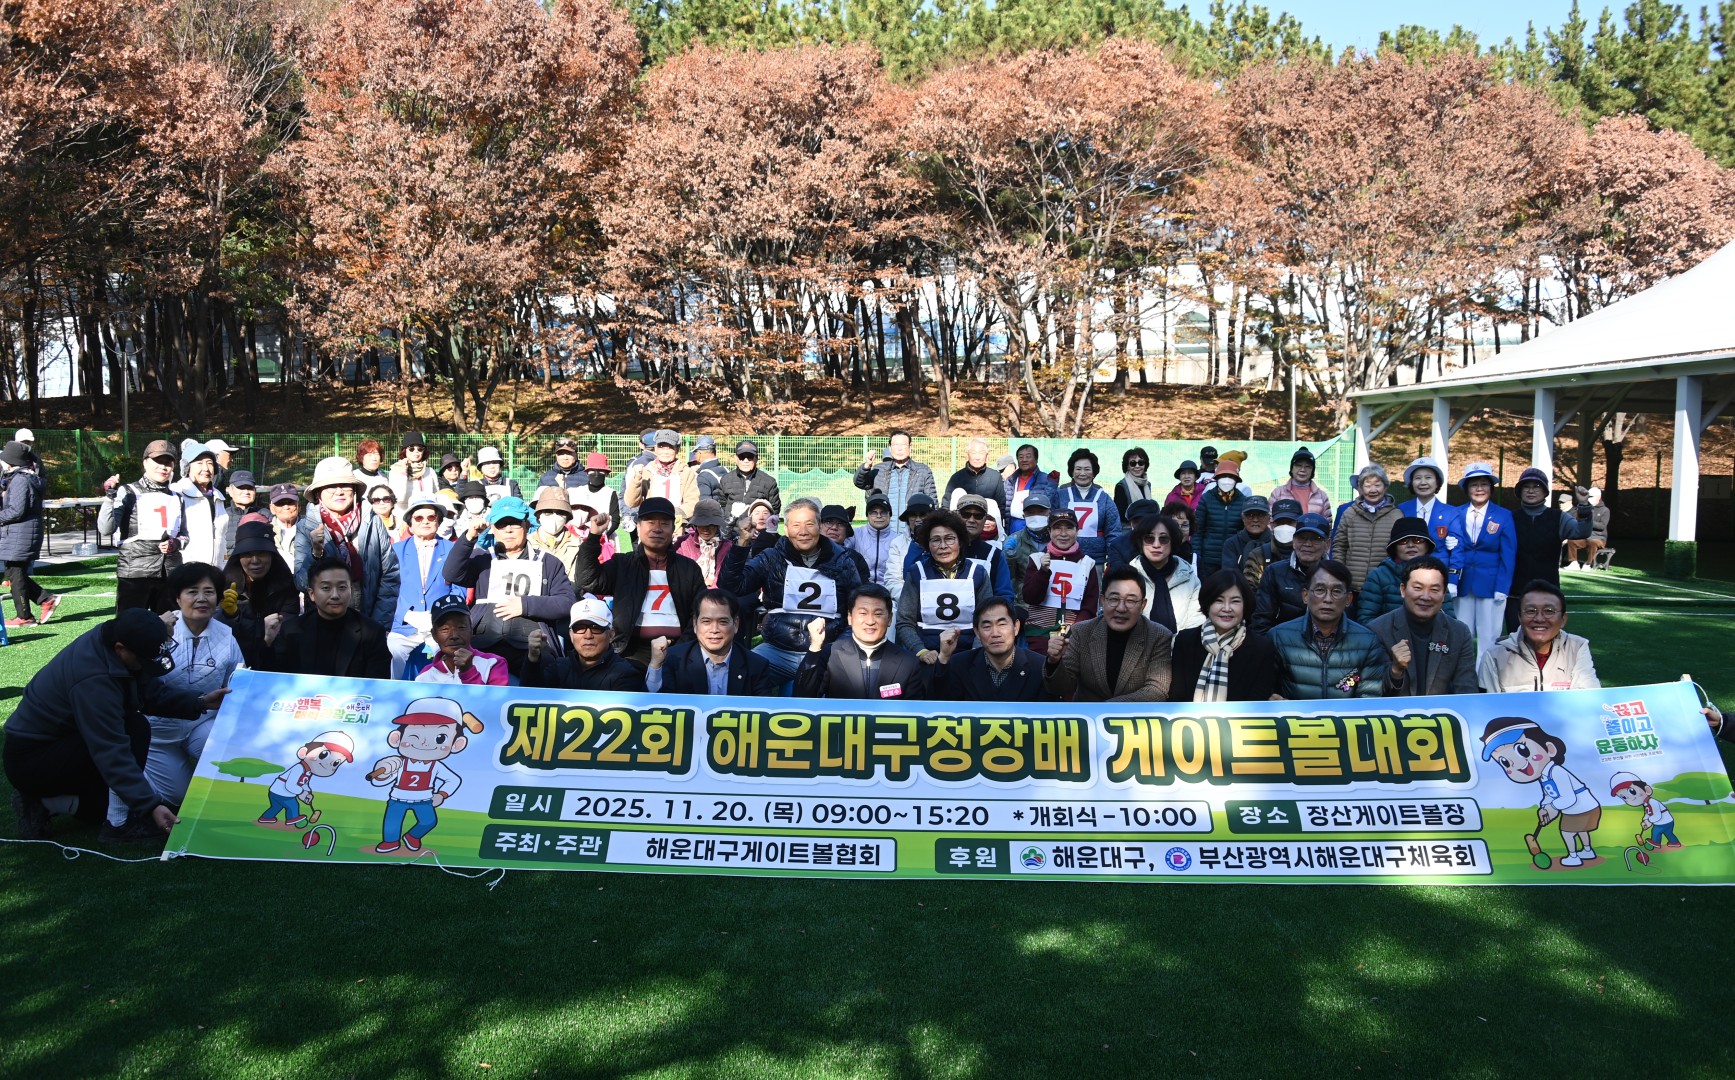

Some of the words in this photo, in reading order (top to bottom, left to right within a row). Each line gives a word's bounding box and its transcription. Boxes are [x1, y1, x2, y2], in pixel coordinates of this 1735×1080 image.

[662, 479, 671, 500] 1
[153, 505, 168, 528] 1
[1074, 506, 1093, 530] 7
[502, 572, 532, 597] 10
[797, 582, 822, 610] 2
[1051, 572, 1073, 596] 5
[647, 585, 671, 610] 7
[936, 593, 961, 621] 8
[506, 706, 686, 767] 제22회
[712, 712, 1082, 774] 해운대구청장배
[1108, 715, 1461, 777] 게이트볼대회
[1595, 733, 1659, 755] 운동하자
[408, 774, 420, 787] 2
[575, 796, 652, 819] 2025.
[665, 799, 703, 821] 11.
[712, 801, 754, 822] 20.
[764, 801, 803, 824] (목)
[812, 803, 989, 827] 09:00~15:20
[1307, 803, 1465, 827] 장산게이트볼장
[494, 832, 602, 856] 주최·주관
[646, 837, 880, 867] 해운대구게이트볼협회
[1052, 845, 1155, 872] 해운대구,
[1199, 844, 1476, 870] 부산광역시해운대구체육회
